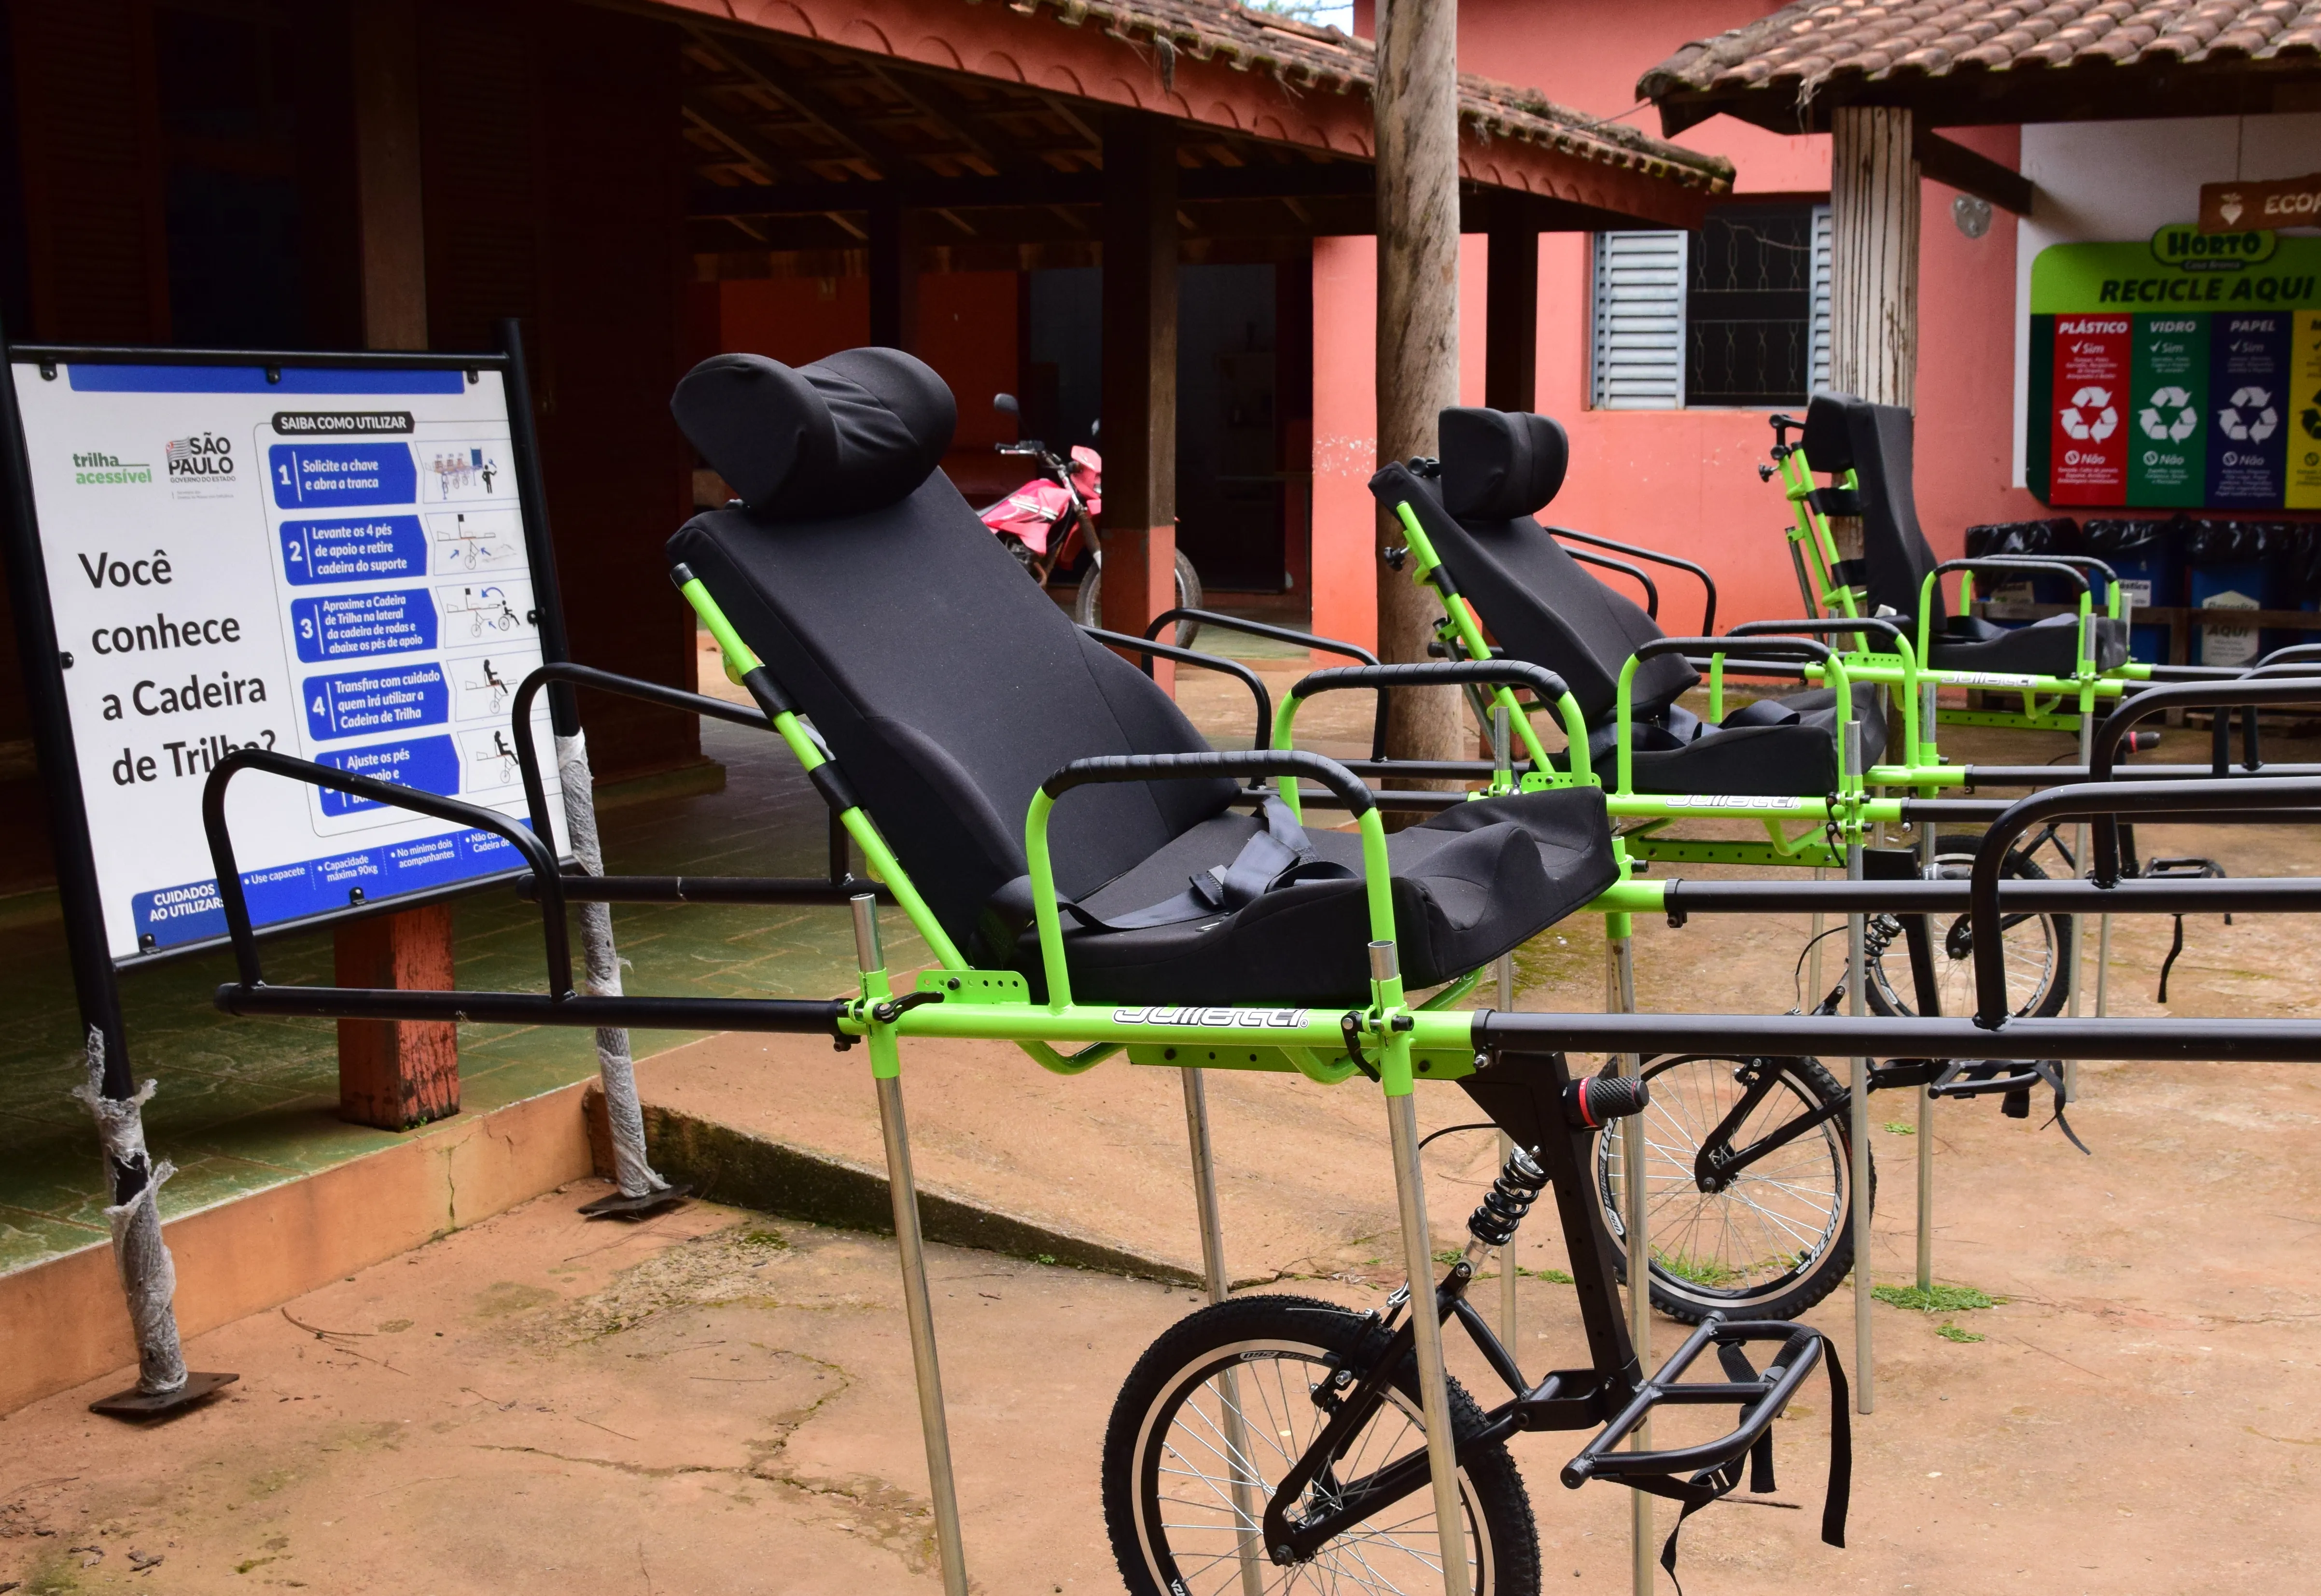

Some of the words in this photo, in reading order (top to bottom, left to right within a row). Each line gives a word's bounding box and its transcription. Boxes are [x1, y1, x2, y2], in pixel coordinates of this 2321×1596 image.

[2168, 232, 2261, 255] HORTO
[2099, 279, 2222, 302] RECICLE
[2230, 276, 2315, 302] AQUI
[2059, 319, 2128, 334] PLÁSTICO
[2150, 322, 2196, 333] VIDRO
[2230, 320, 2275, 332] PAPEL
[2083, 342, 2105, 354] Sim
[2162, 342, 2184, 353] Sim
[281, 418, 316, 429] SAIBA
[317, 417, 353, 429] COMO
[357, 416, 406, 429] UTILIZAR
[190, 432, 231, 455] SÃO
[73, 452, 120, 467] trilha
[169, 457, 234, 475] PAULO
[303, 461, 339, 473] Solicite
[341, 463, 348, 471] a
[350, 460, 378, 471] chave
[76, 468, 152, 484] acessível
[279, 465, 291, 485] 1
[313, 479, 336, 490] abra
[347, 478, 378, 489] tranca
[313, 527, 351, 539] Levante
[354, 529, 364, 538] os
[367, 525, 374, 536] 4
[375, 524, 392, 539] pés
[289, 542, 302, 561] 2
[315, 546, 328, 557] de
[330, 545, 357, 558] apoio
[359, 546, 365, 554] e
[367, 542, 393, 553] retire
[78, 549, 172, 588] Você
[318, 563, 354, 575] cadeira
[357, 561, 369, 572] do
[371, 559, 407, 574] suporte
[323, 599, 364, 613] Aproxime
[366, 599, 372, 607] a
[374, 594, 406, 606] Cadeira
[325, 613, 336, 625] de
[337, 611, 362, 623] Trilha
[364, 611, 375, 621] na
[377, 608, 403, 620] lateral
[92, 613, 240, 655] conhece
[301, 619, 313, 639] 3
[327, 629, 338, 640] da
[340, 625, 371, 638] cadeira
[373, 624, 384, 635] de
[386, 622, 409, 633] rodas
[410, 623, 416, 631] e
[330, 641, 358, 654] abaixe
[360, 641, 369, 650] os
[371, 637, 386, 651] pés
[388, 636, 398, 647] de
[400, 634, 422, 648] apoio
[336, 678, 378, 694] Transfira
[380, 678, 401, 688] com
[403, 671, 440, 686] cuidado
[102, 693, 123, 721] a
[133, 671, 266, 715] Cadeira
[338, 699, 365, 713] quem
[367, 694, 380, 705] irá
[383, 690, 417, 705] utilizar
[418, 692, 424, 700] a
[312, 696, 325, 716] 4
[341, 714, 378, 728] Cadeira
[380, 713, 392, 724] de
[395, 708, 421, 721] Trilha
[112, 748, 157, 786] de
[347, 755, 379, 770] Ajuste
[380, 754, 391, 765] os
[393, 748, 410, 764] pés
[393, 770, 400, 779] e
[471, 832, 486, 843] Não
[397, 848, 409, 857] No
[410, 843, 436, 854] mínimo
[437, 839, 453, 850] dois
[473, 841, 500, 853] Cadeira
[324, 855, 369, 872] Capacidade
[399, 850, 455, 868] acompanhantes
[251, 874, 267, 884] Use
[269, 867, 305, 881] capacete
[327, 868, 357, 882] máxima
[154, 883, 215, 907] CUIDADOS
[150, 908, 168, 922] AO
[1811, 1192, 1841, 1264] AERO
